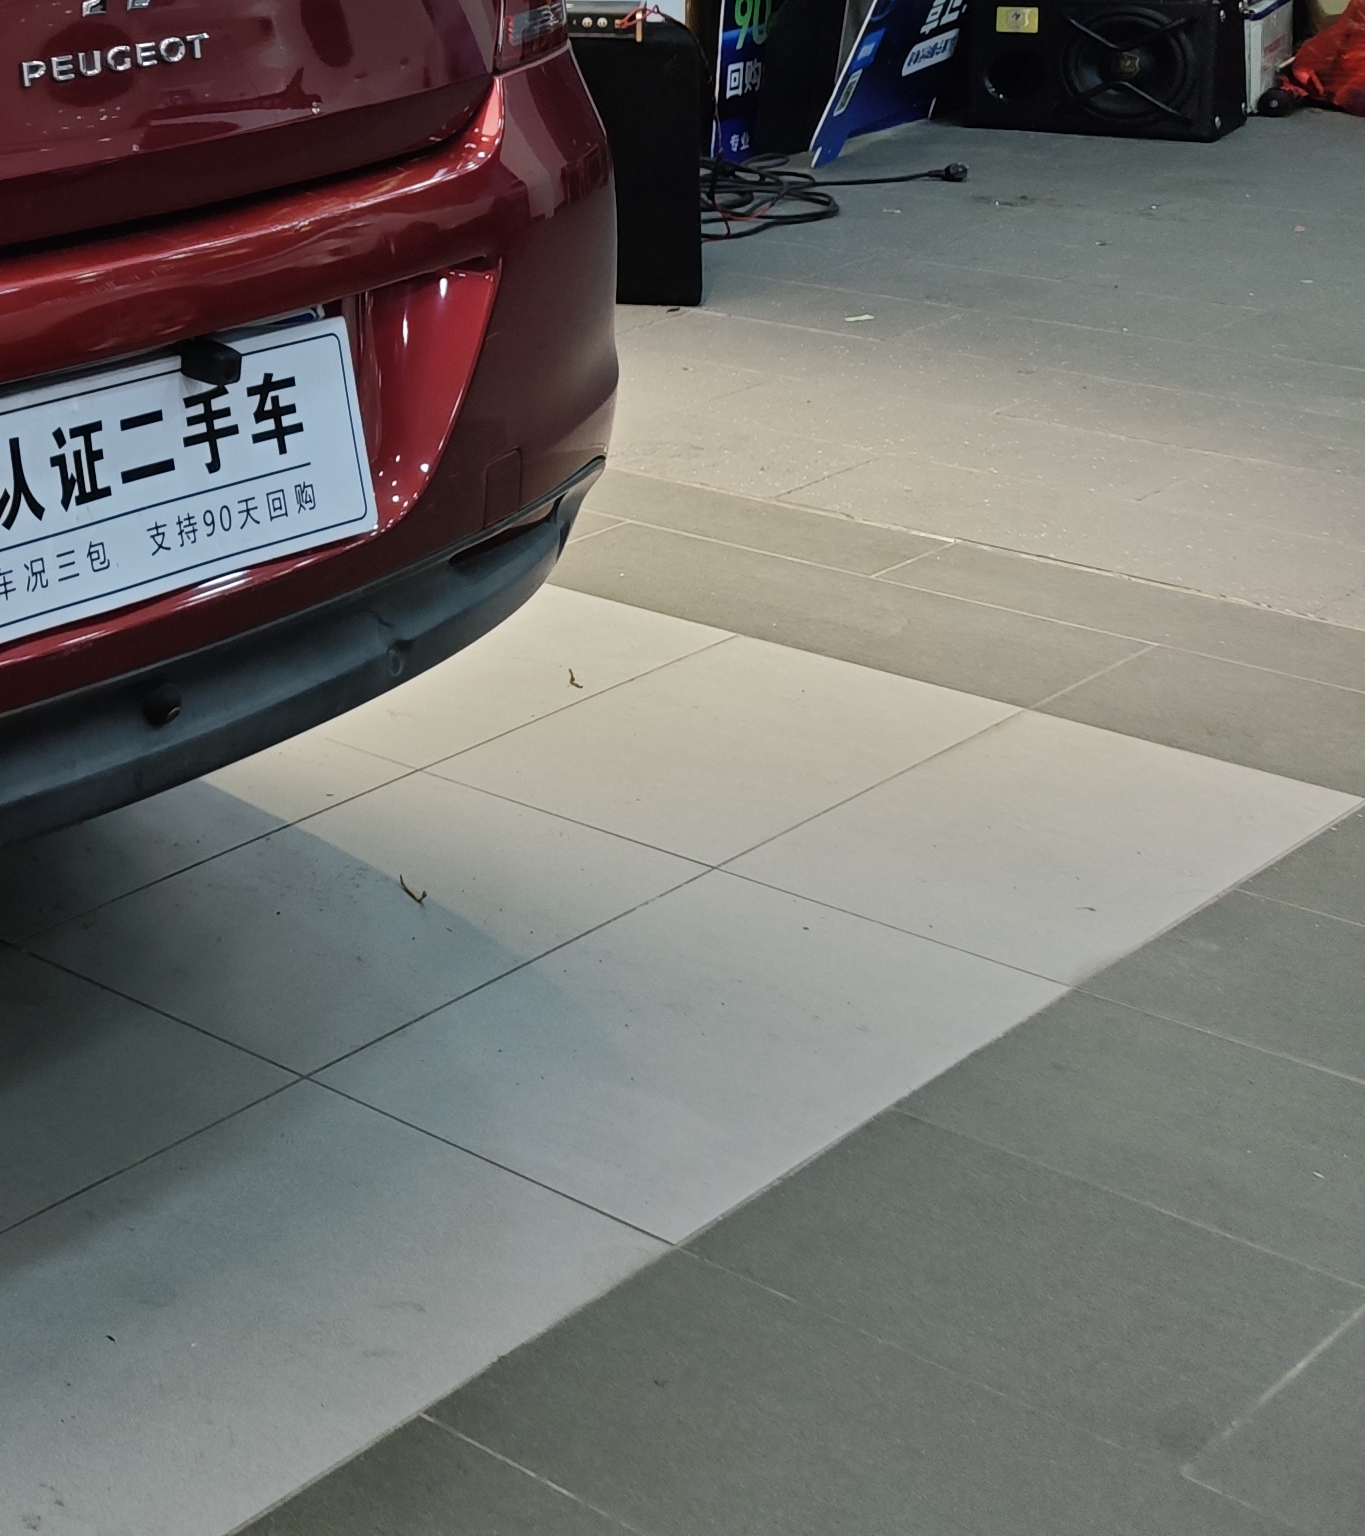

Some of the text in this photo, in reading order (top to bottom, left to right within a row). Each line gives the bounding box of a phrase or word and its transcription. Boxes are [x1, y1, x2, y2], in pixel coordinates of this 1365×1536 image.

[21, 32, 210, 88] PEUGEOT
[725, 58, 762, 100] 回购
[146, 481, 317, 556] 支持90天回购
